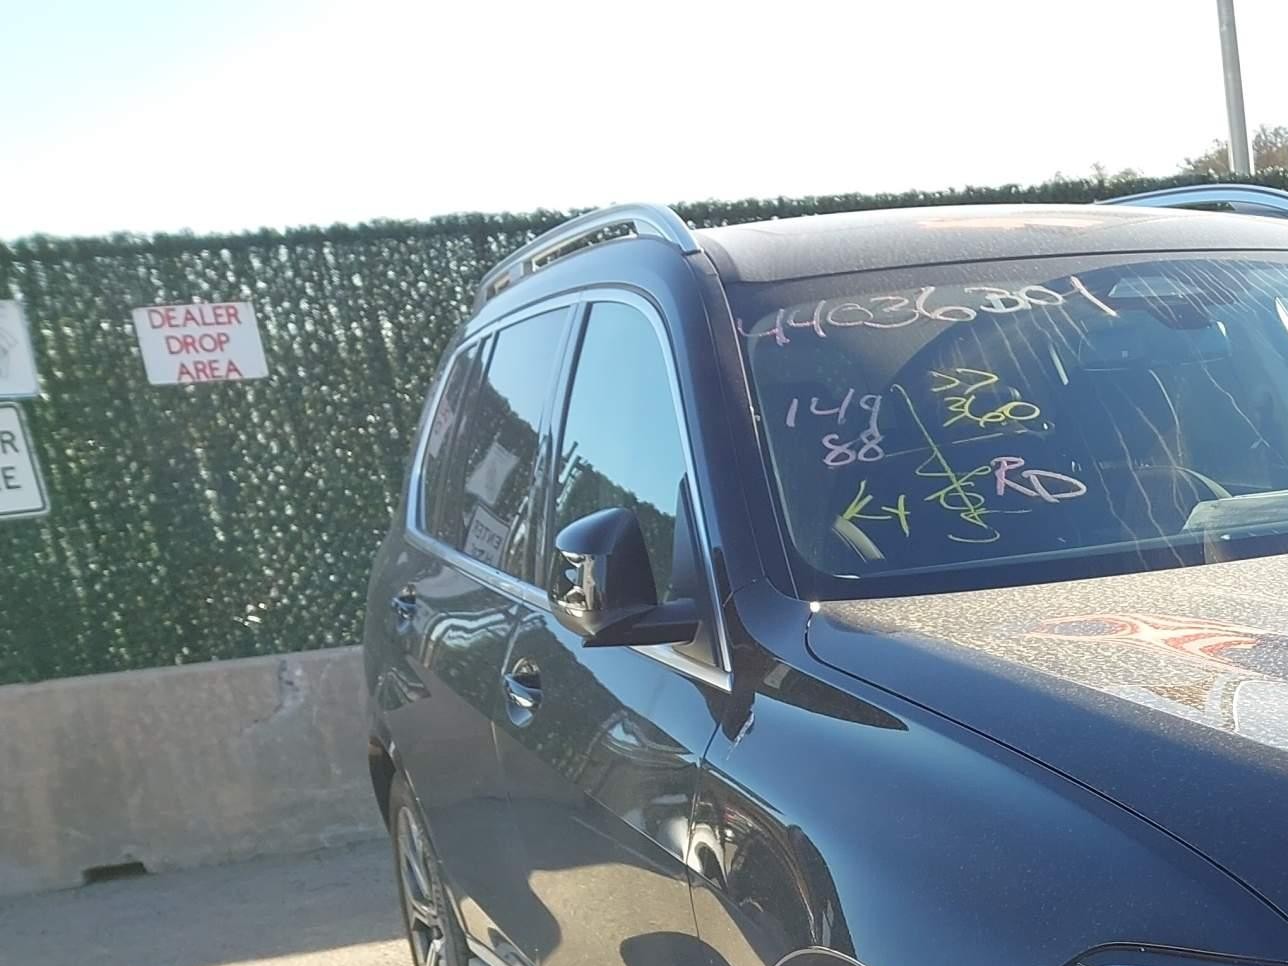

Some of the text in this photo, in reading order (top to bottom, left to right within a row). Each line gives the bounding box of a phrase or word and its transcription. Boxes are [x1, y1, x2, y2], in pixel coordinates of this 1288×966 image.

[148, 305, 242, 330] DEALER
[165, 332, 230, 355] DROP
[178, 359, 243, 382] AREA
